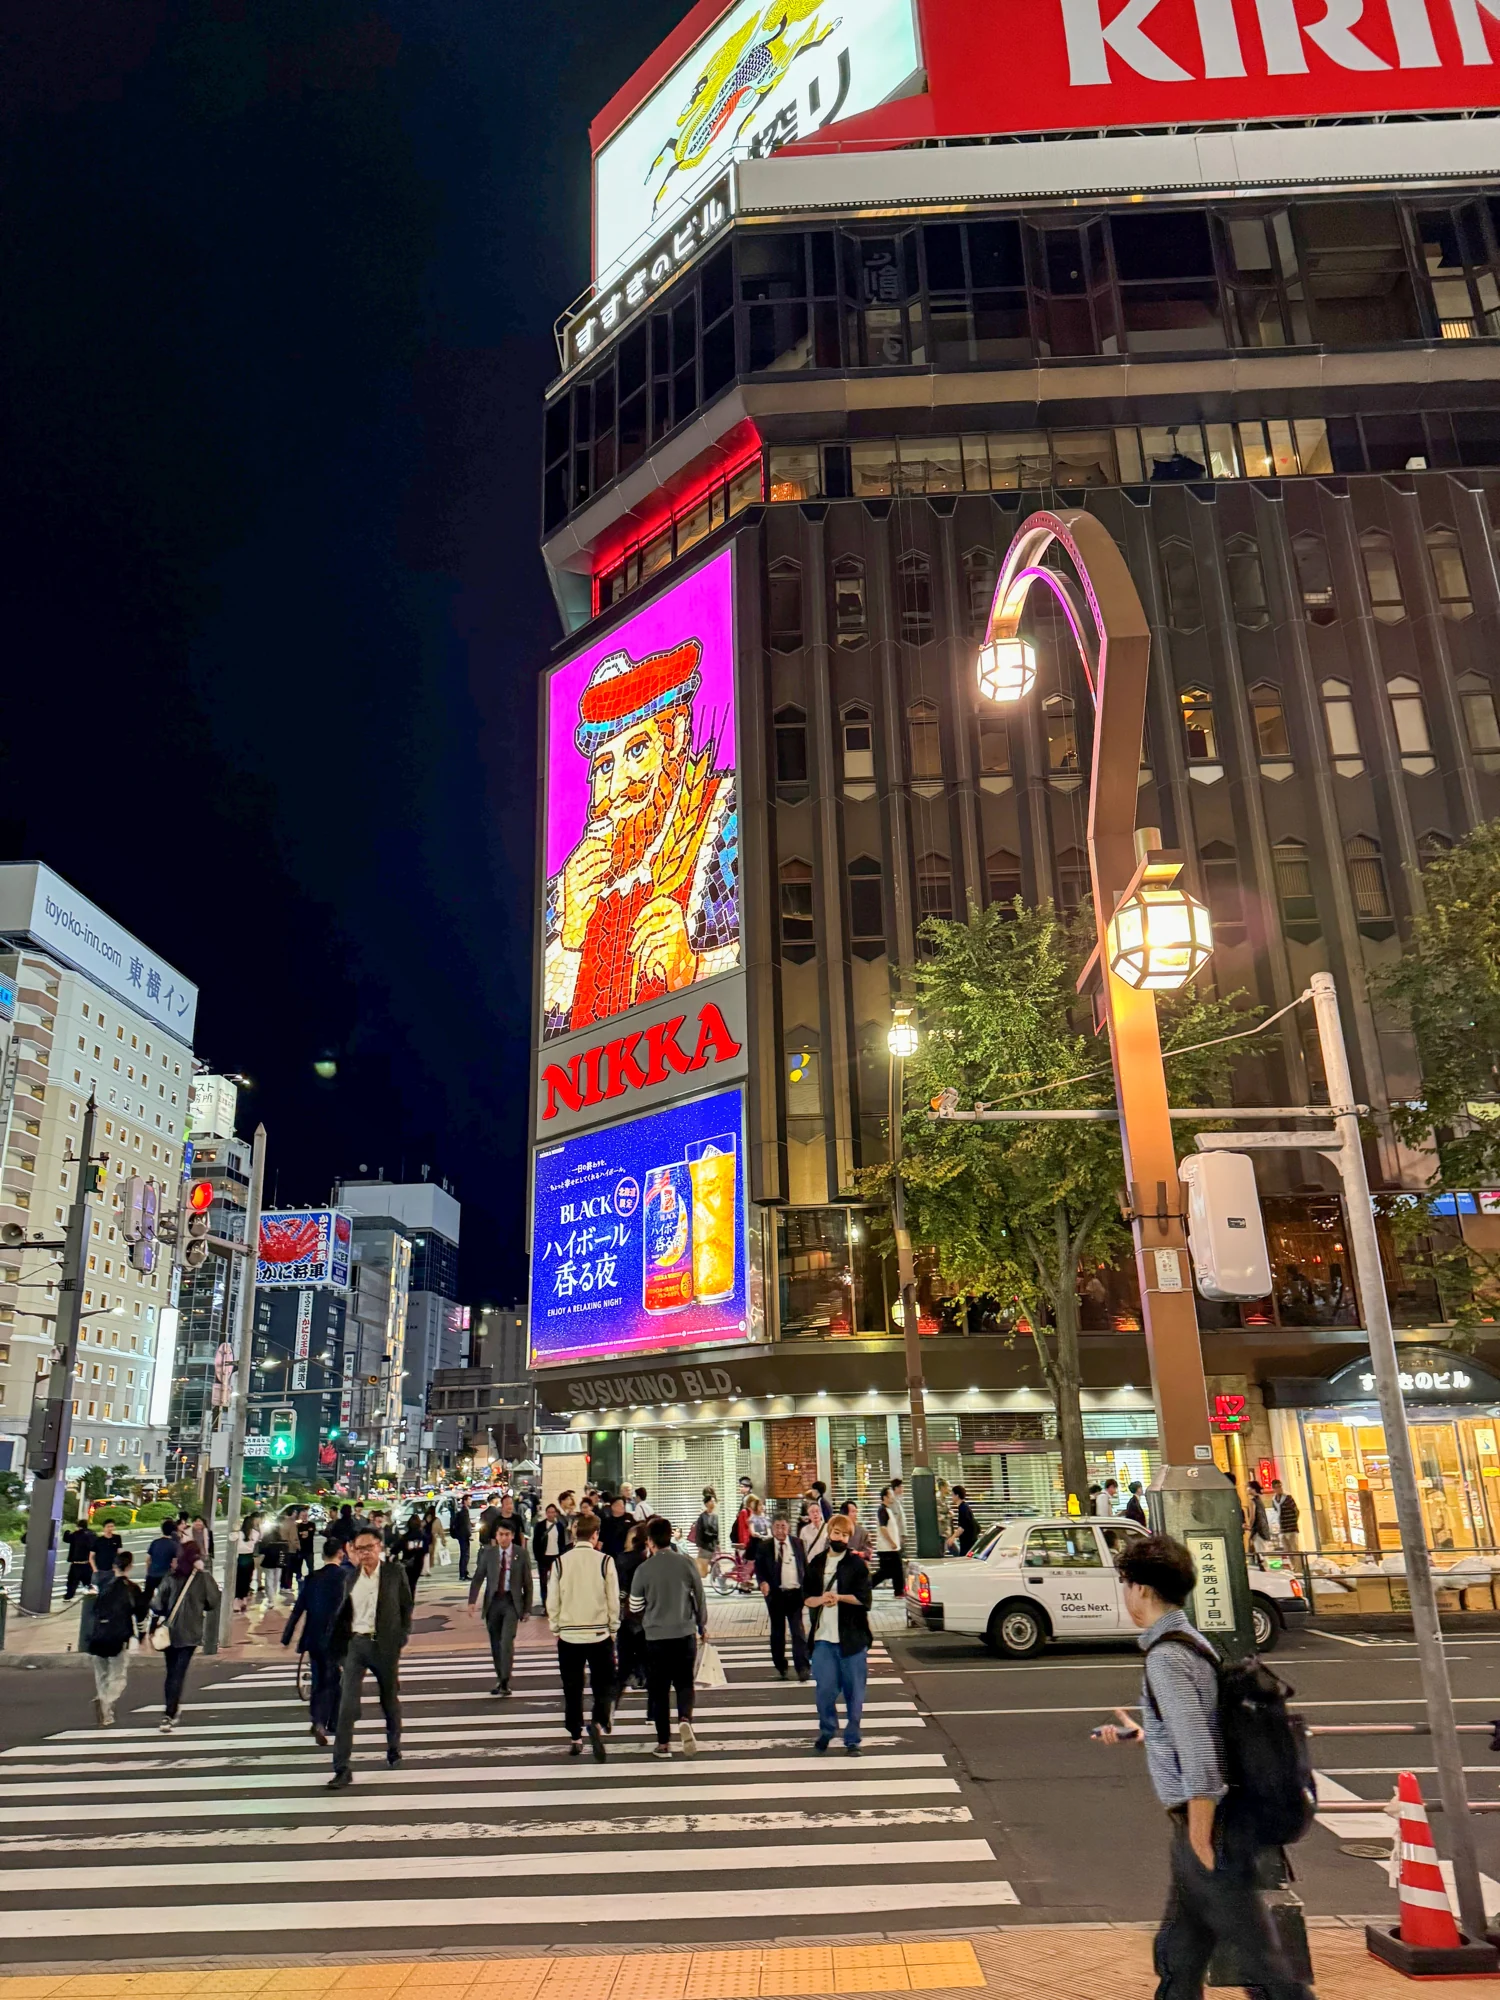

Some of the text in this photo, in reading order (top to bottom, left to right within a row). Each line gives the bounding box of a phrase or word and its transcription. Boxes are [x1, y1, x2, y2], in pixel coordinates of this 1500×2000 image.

[575, 197, 724, 353] すすきのビル
[45, 895, 190, 1017] toyoko-inn.com 東横イン
[541, 1002, 742, 1120] NIKKA
[560, 1194, 612, 1225] BLACK
[542, 1222, 632, 1261] ハイボール
[256, 1263, 325, 1280] かに将軍
[552, 1251, 619, 1298] 香る夜
[547, 1307, 567, 1317] ENJOY
[572, 1301, 602, 1313] RELAXING
[603, 1297, 623, 1307] NIGHT
[567, 1368, 742, 1407] SUSUKINO BLD.
[1358, 1370, 1471, 1391] すきのビル
[1060, 1593, 1082, 1601] TAXI
[1199, 1541, 1222, 1619] 南4条西4丁目
[1061, 1604, 1112, 1612] GOes Next.
